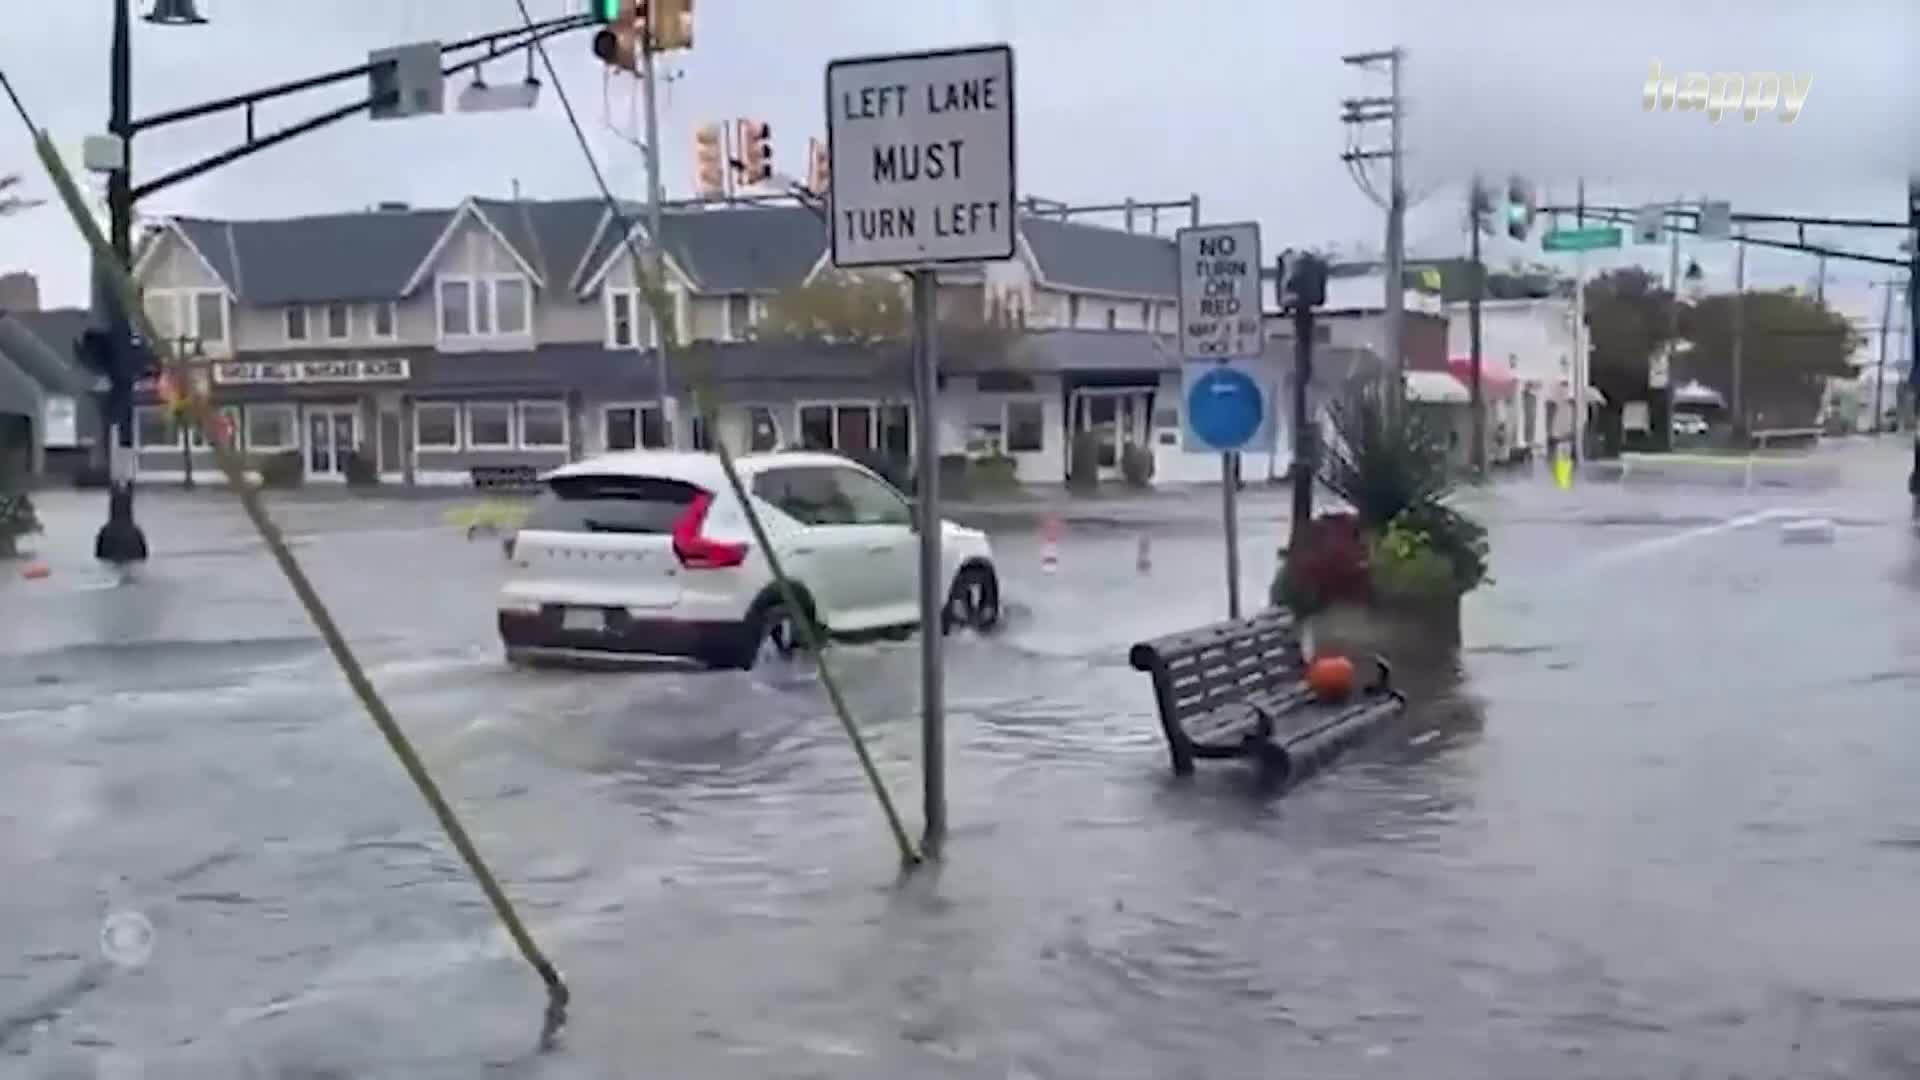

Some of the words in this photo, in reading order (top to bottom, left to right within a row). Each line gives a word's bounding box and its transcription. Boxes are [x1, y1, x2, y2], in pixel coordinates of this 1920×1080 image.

[844, 84, 908, 120] LEFT
[928, 77, 1000, 114] LANE
[873, 139, 964, 183] MUST
[844, 206, 915, 240] TURN
[934, 202, 1000, 237] LEFT
[1200, 235, 1236, 256] NO
[1197, 260, 1246, 277] TURN
[1204, 279, 1234, 298] ON
[1201, 298, 1240, 316] RED
